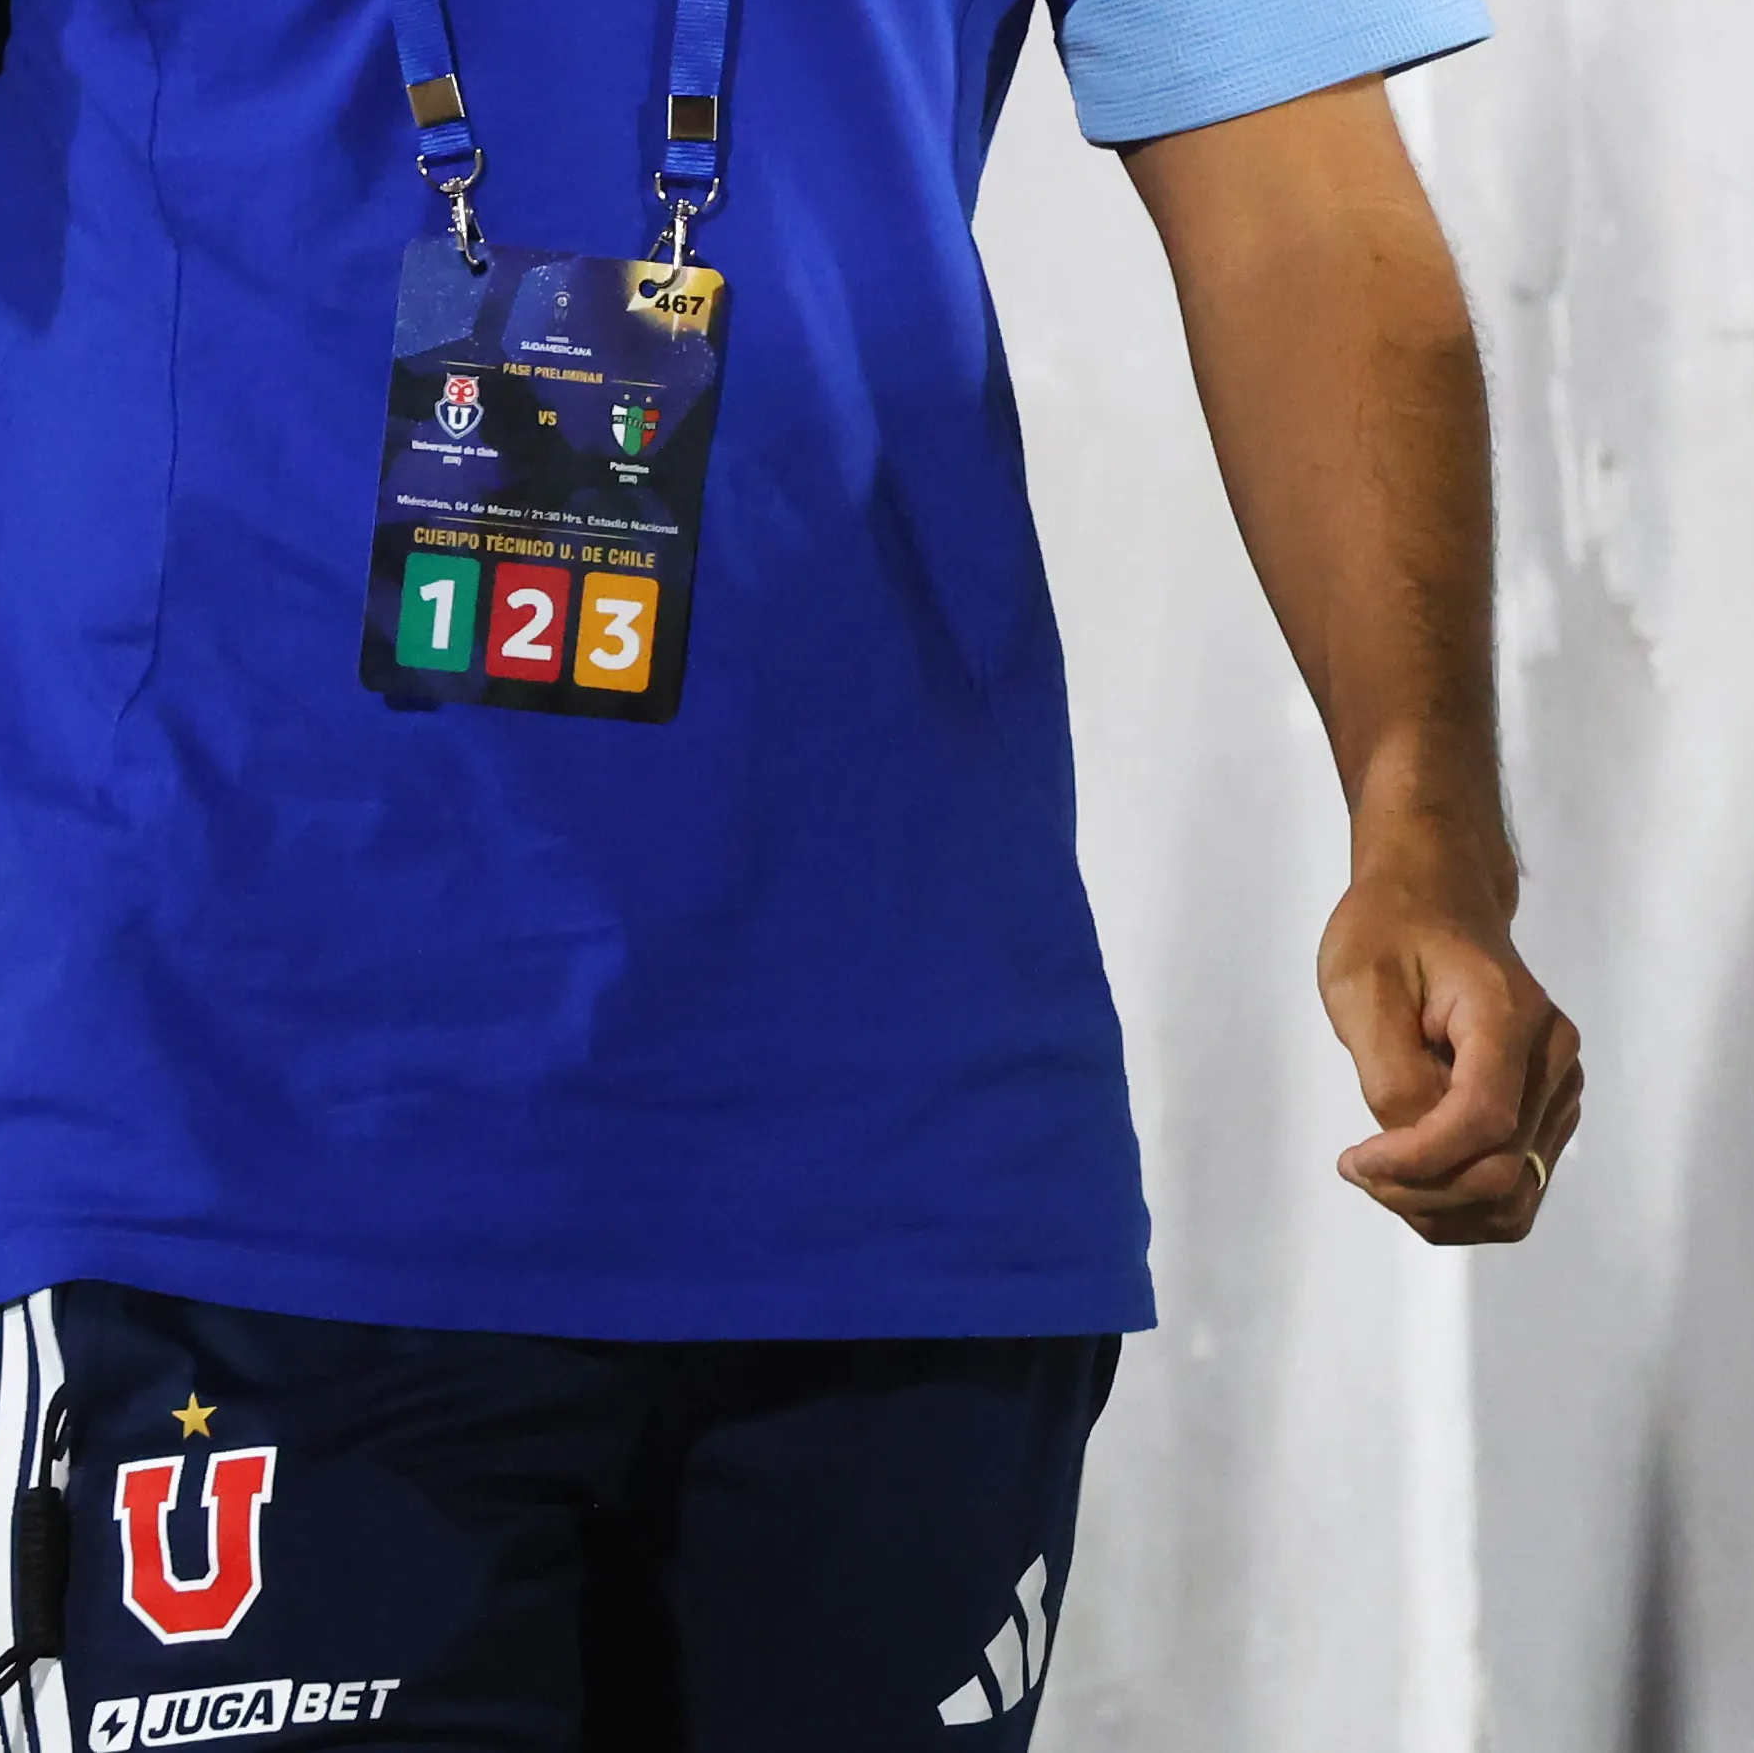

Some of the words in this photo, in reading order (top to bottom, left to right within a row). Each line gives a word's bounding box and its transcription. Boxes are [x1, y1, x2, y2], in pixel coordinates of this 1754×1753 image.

[654, 294, 705, 315] 467
[520, 340, 592, 357] SUDAMERICANA
[503, 362, 532, 376] FASE
[447, 406, 472, 430] U
[538, 410, 557, 426] VS
[470, 503, 485, 513] de
[487, 504, 522, 518] Marzo
[587, 515, 628, 530] Estadio
[630, 520, 679, 535] Nacional
[414, 526, 480, 550] CUERPO
[485, 533, 554, 559] TÉCNICO
[560, 543, 575, 560] U.
[582, 546, 603, 563] DE
[608, 548, 656, 569] CHILE
[419, 579, 455, 650] 1
[501, 588, 554, 661] 2
[589, 597, 643, 671] 3
[113, 1446, 278, 1645] U
